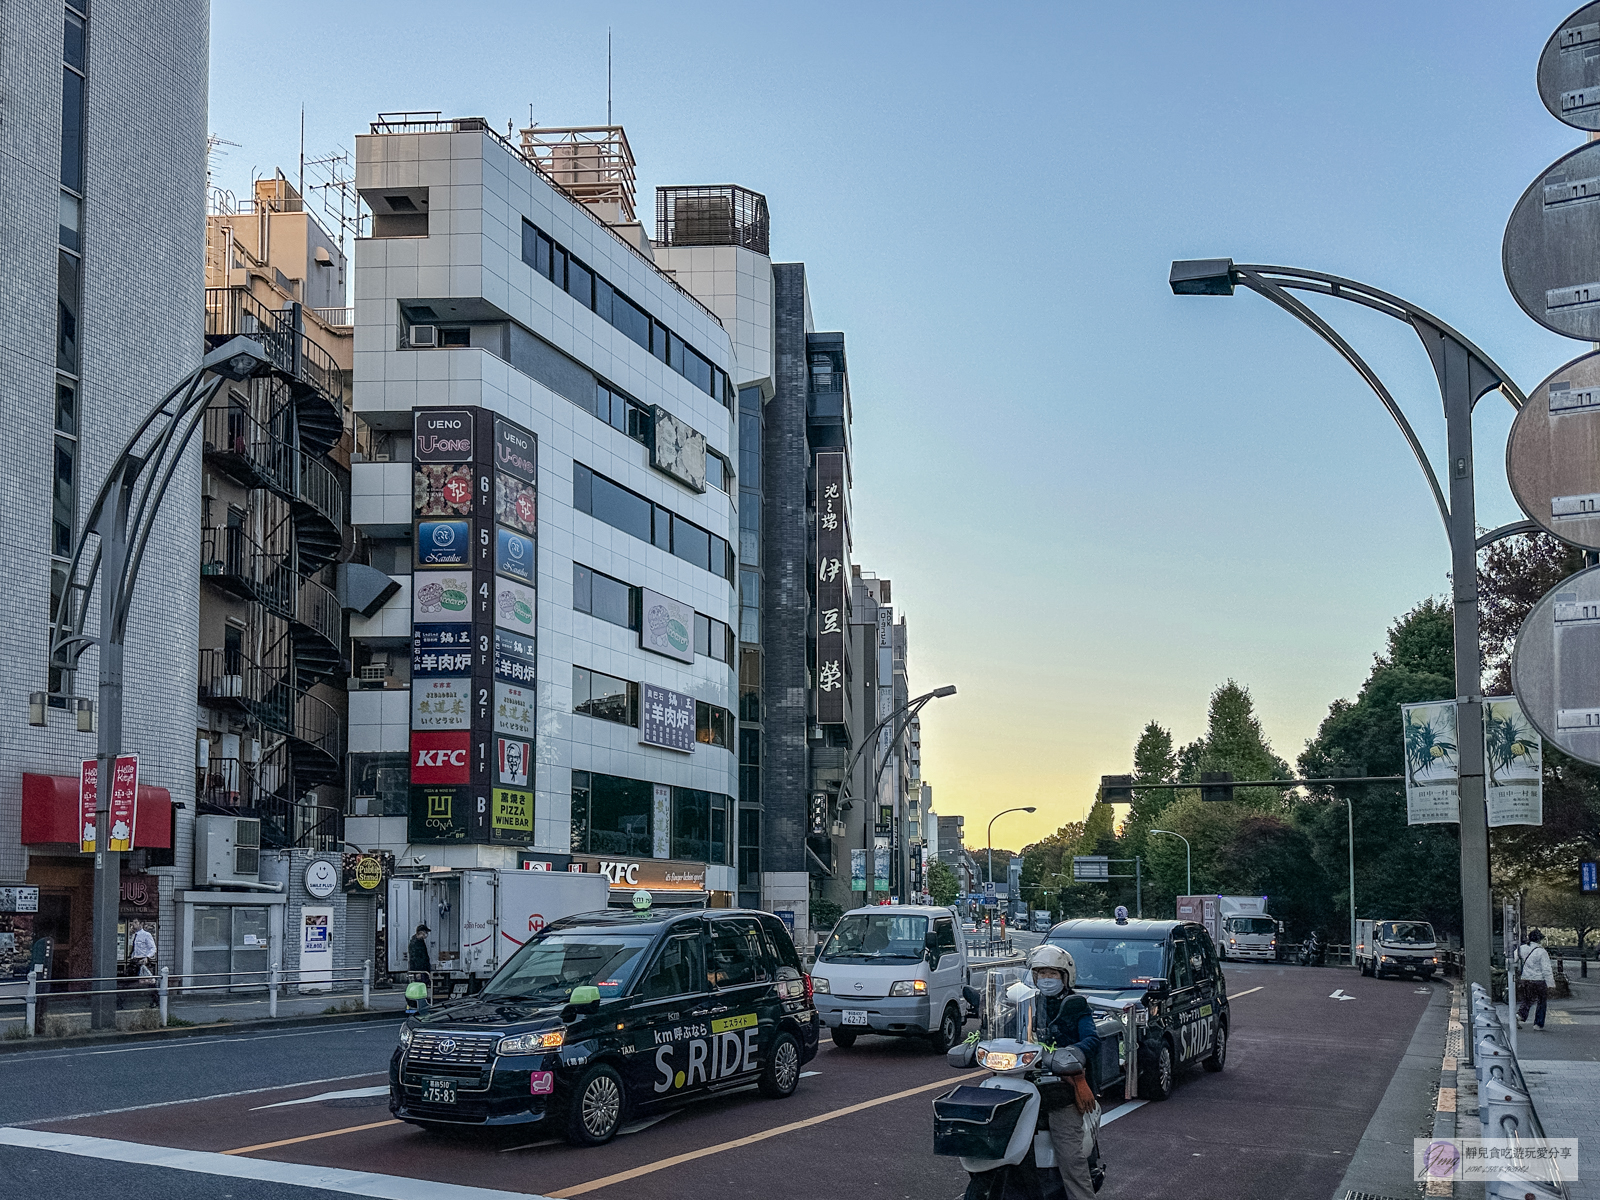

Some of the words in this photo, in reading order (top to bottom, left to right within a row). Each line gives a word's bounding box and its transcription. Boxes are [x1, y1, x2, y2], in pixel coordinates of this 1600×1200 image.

[428, 420, 461, 429] UENO
[504, 431, 528, 450] UENO
[421, 654, 471, 671] 羊肉炉
[501, 659, 535, 682] 羊肉炉
[651, 702, 689, 729] 羊肉炉
[416, 750, 466, 767] KFC
[1419, 789, 1458, 797] 田中一村展
[1499, 790, 1538, 798] 田中一村展
[500, 805, 525, 817] PIZZA
[426, 819, 453, 831] CONA
[496, 816, 514, 826] WINE
[515, 818, 529, 828] BAR
[600, 862, 639, 884] KFC
[120, 883, 148, 905] HUB
[667, 1011, 680, 1021] km
[848, 1016, 866, 1024] 62-73
[723, 1018, 748, 1029] エスライド
[674, 1023, 707, 1042] 呼ぶなら
[1180, 1016, 1213, 1062] S.RIDE
[621, 1045, 635, 1055] TAXI
[653, 1028, 759, 1093] S.RIDE
[429, 1088, 455, 1102] 75-83
